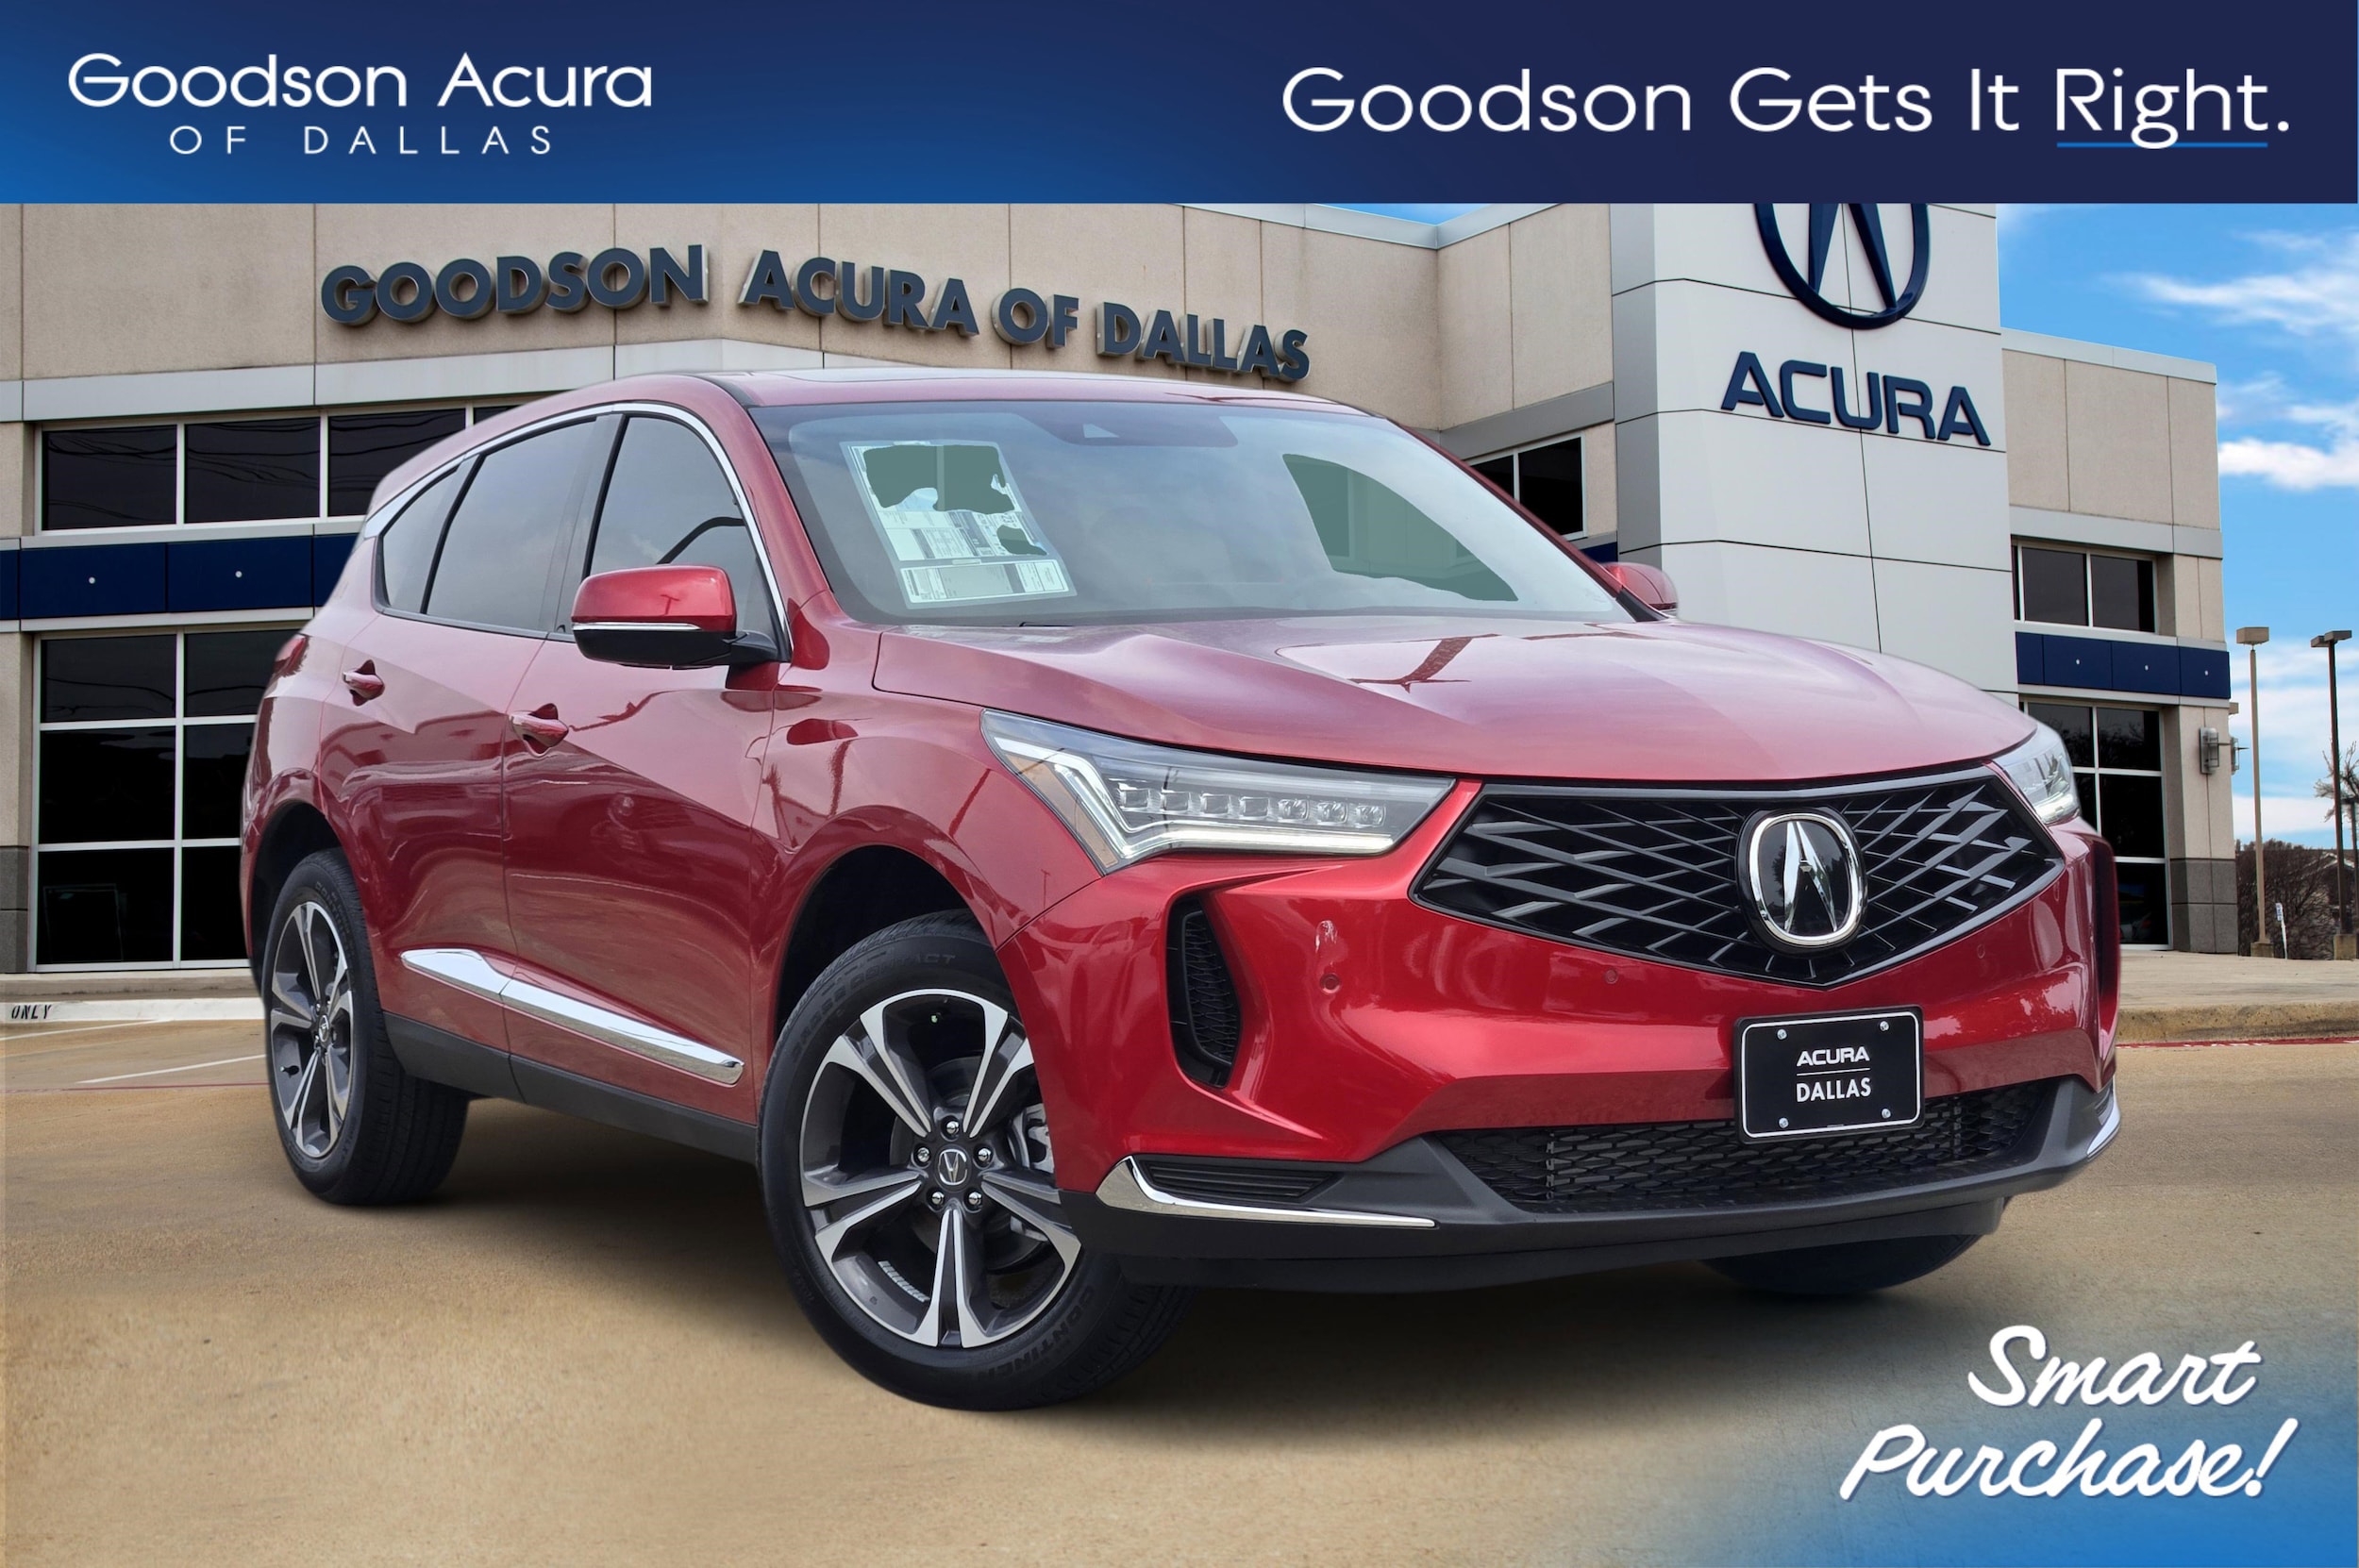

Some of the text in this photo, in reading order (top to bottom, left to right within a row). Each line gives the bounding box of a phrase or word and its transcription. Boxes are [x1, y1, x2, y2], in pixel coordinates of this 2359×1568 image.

[321, 244, 1311, 382] GOODSON ACURA OF DALLAS
[1720, 350, 1992, 446] ACURA
[10, 1004, 53, 1020] ONLY
[1796, 1046, 1871, 1067] ACURA
[1796, 1076, 1872, 1103] DALLAS
